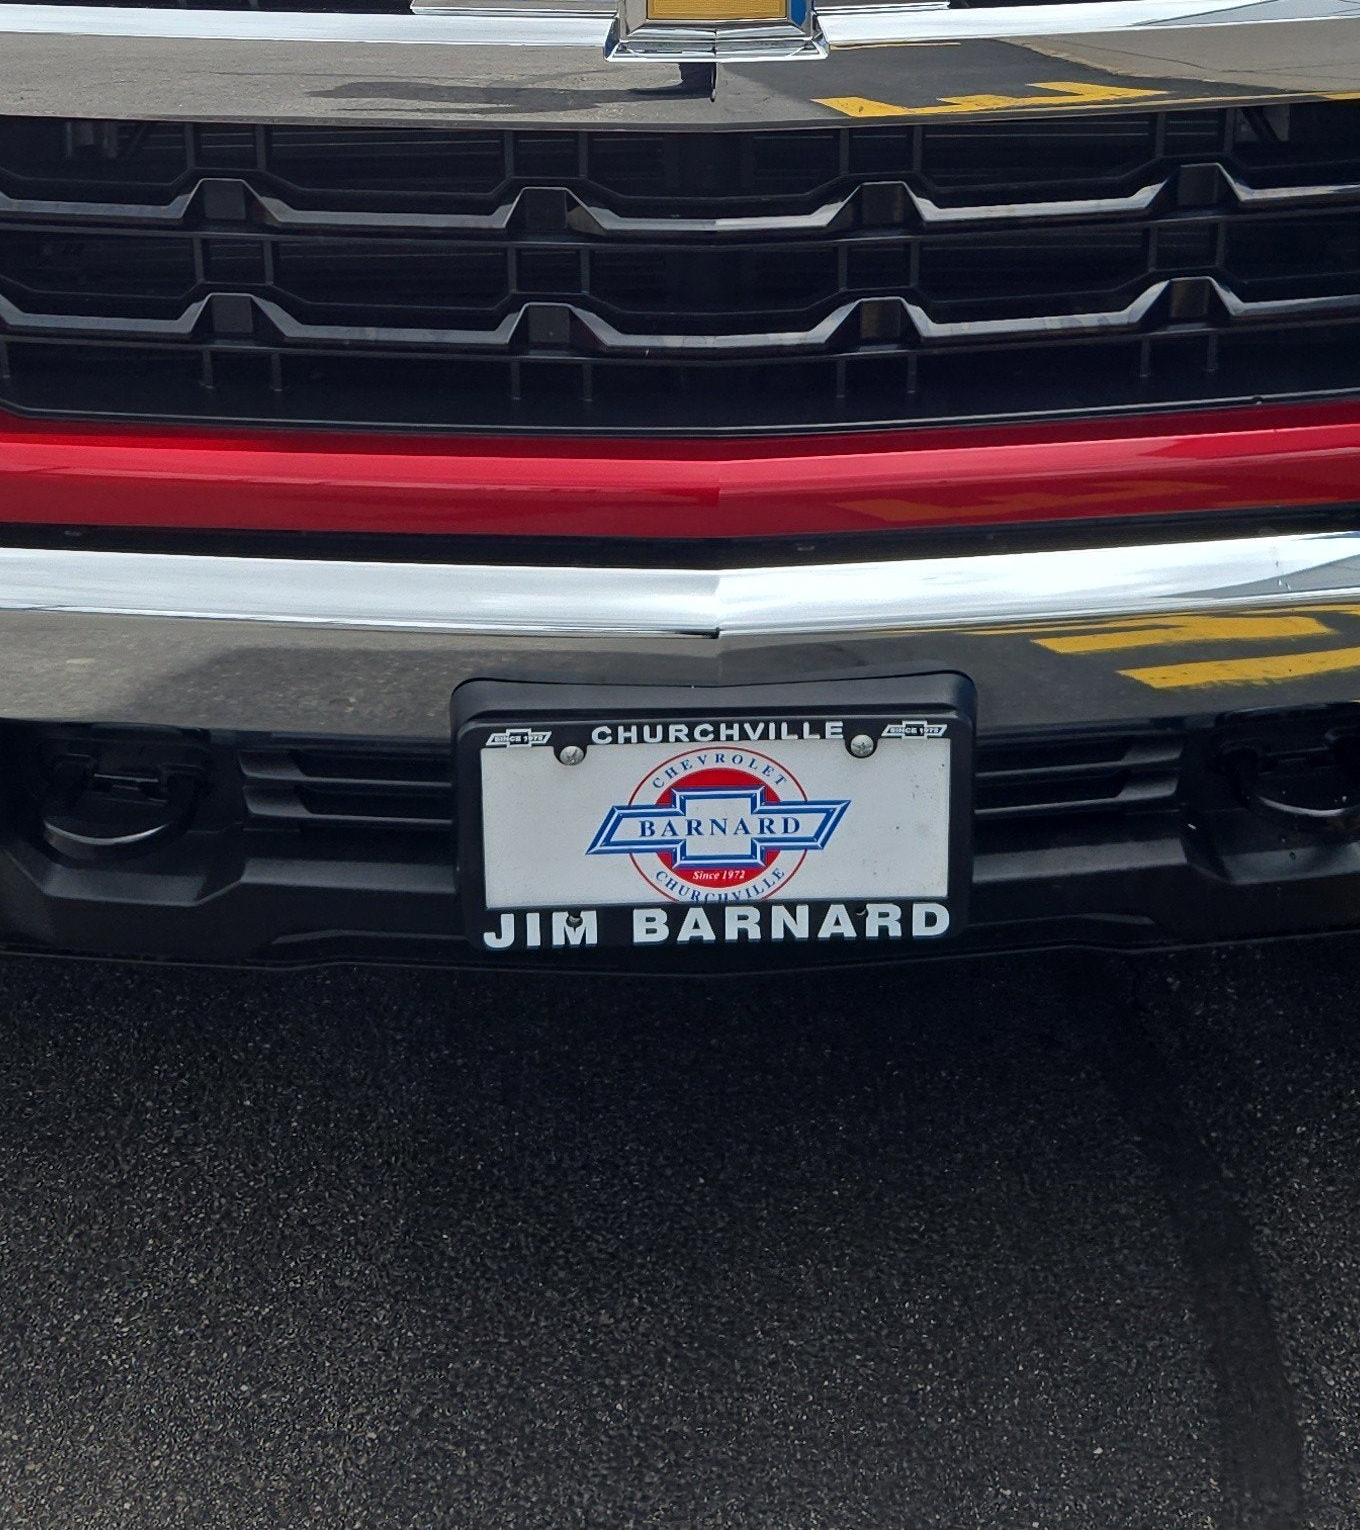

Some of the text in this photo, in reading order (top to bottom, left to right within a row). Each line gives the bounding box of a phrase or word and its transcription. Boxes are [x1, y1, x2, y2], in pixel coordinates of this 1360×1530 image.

[590, 720, 844, 745] CHURCHVILLE
[652, 752, 788, 790] CHEVROLET
[638, 816, 801, 838] BARNARD
[655, 867, 785, 903] CHURCHVILLE
[692, 870, 746, 880] Since 1972
[483, 902, 951, 949] JIM BARNARD
